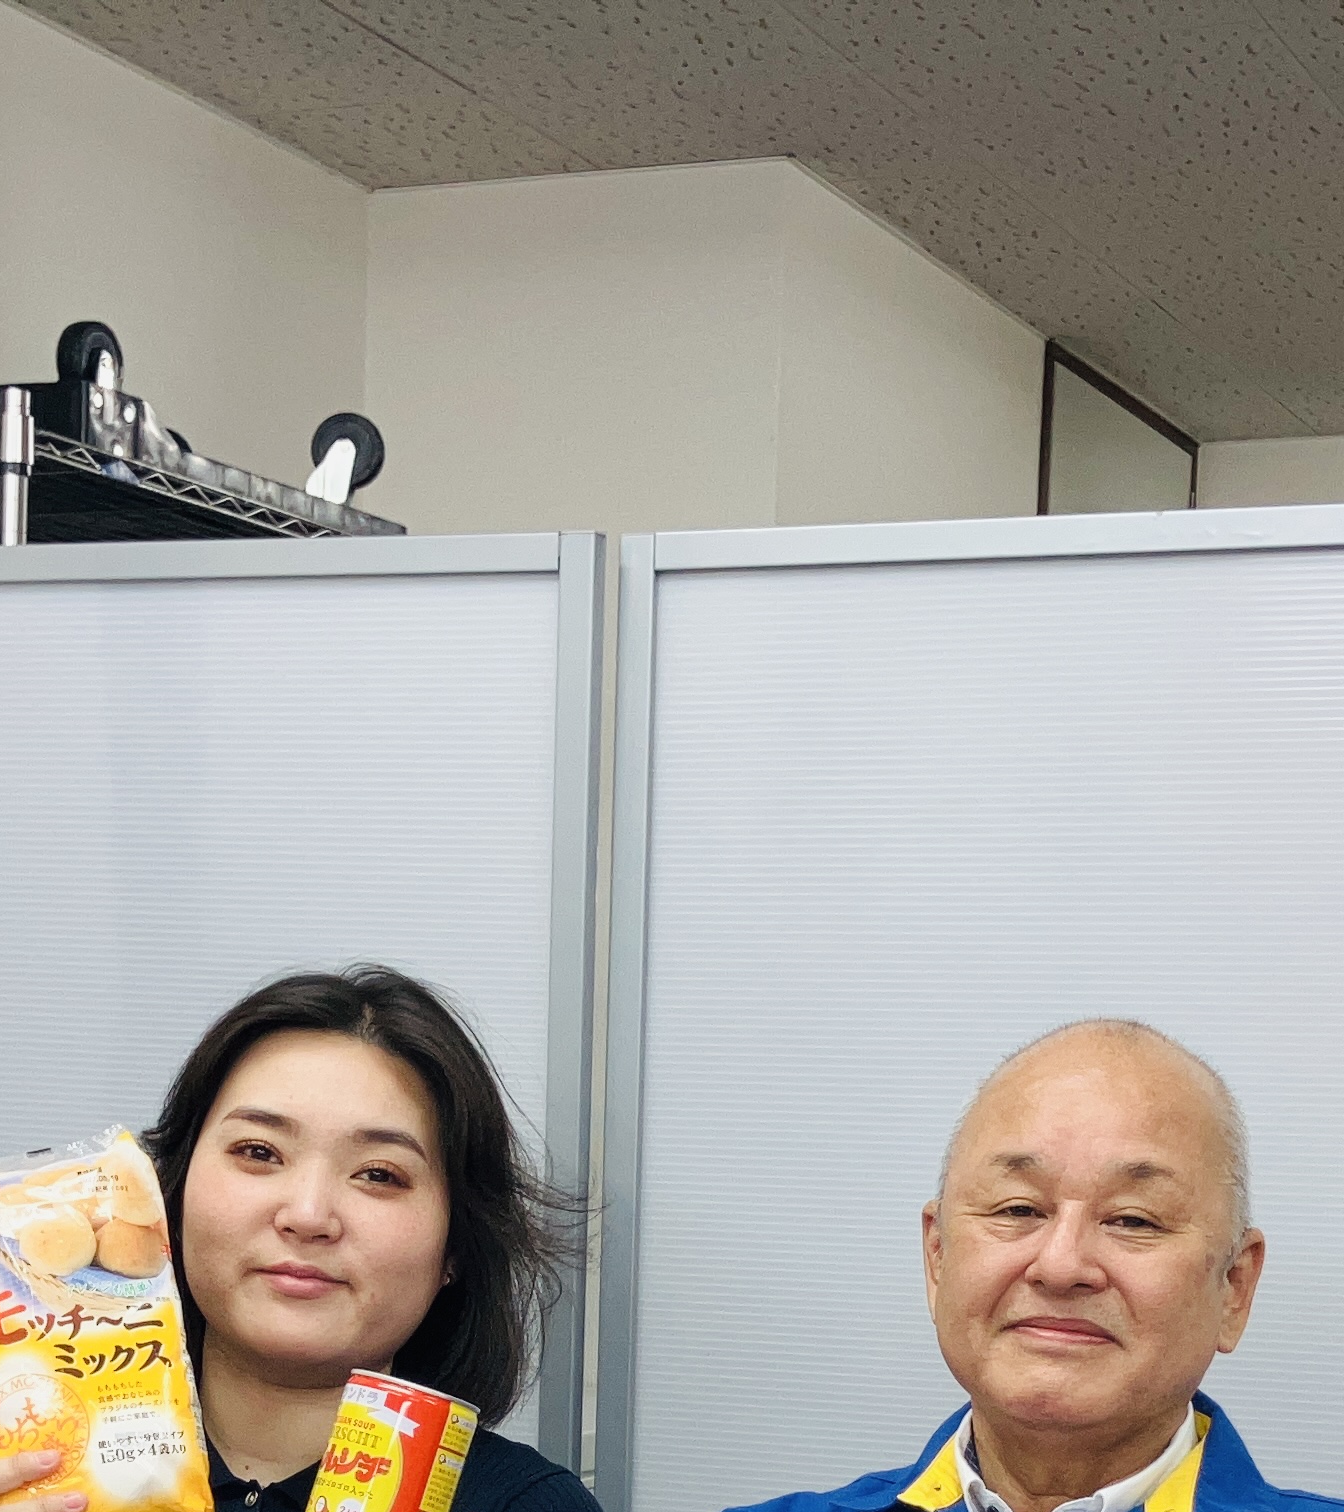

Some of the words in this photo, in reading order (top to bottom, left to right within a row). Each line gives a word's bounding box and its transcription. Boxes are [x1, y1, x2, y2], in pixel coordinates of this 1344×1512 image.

[54, 1340, 172, 1378] ミックス
[343, 1386, 378, 1404] ンドラ
